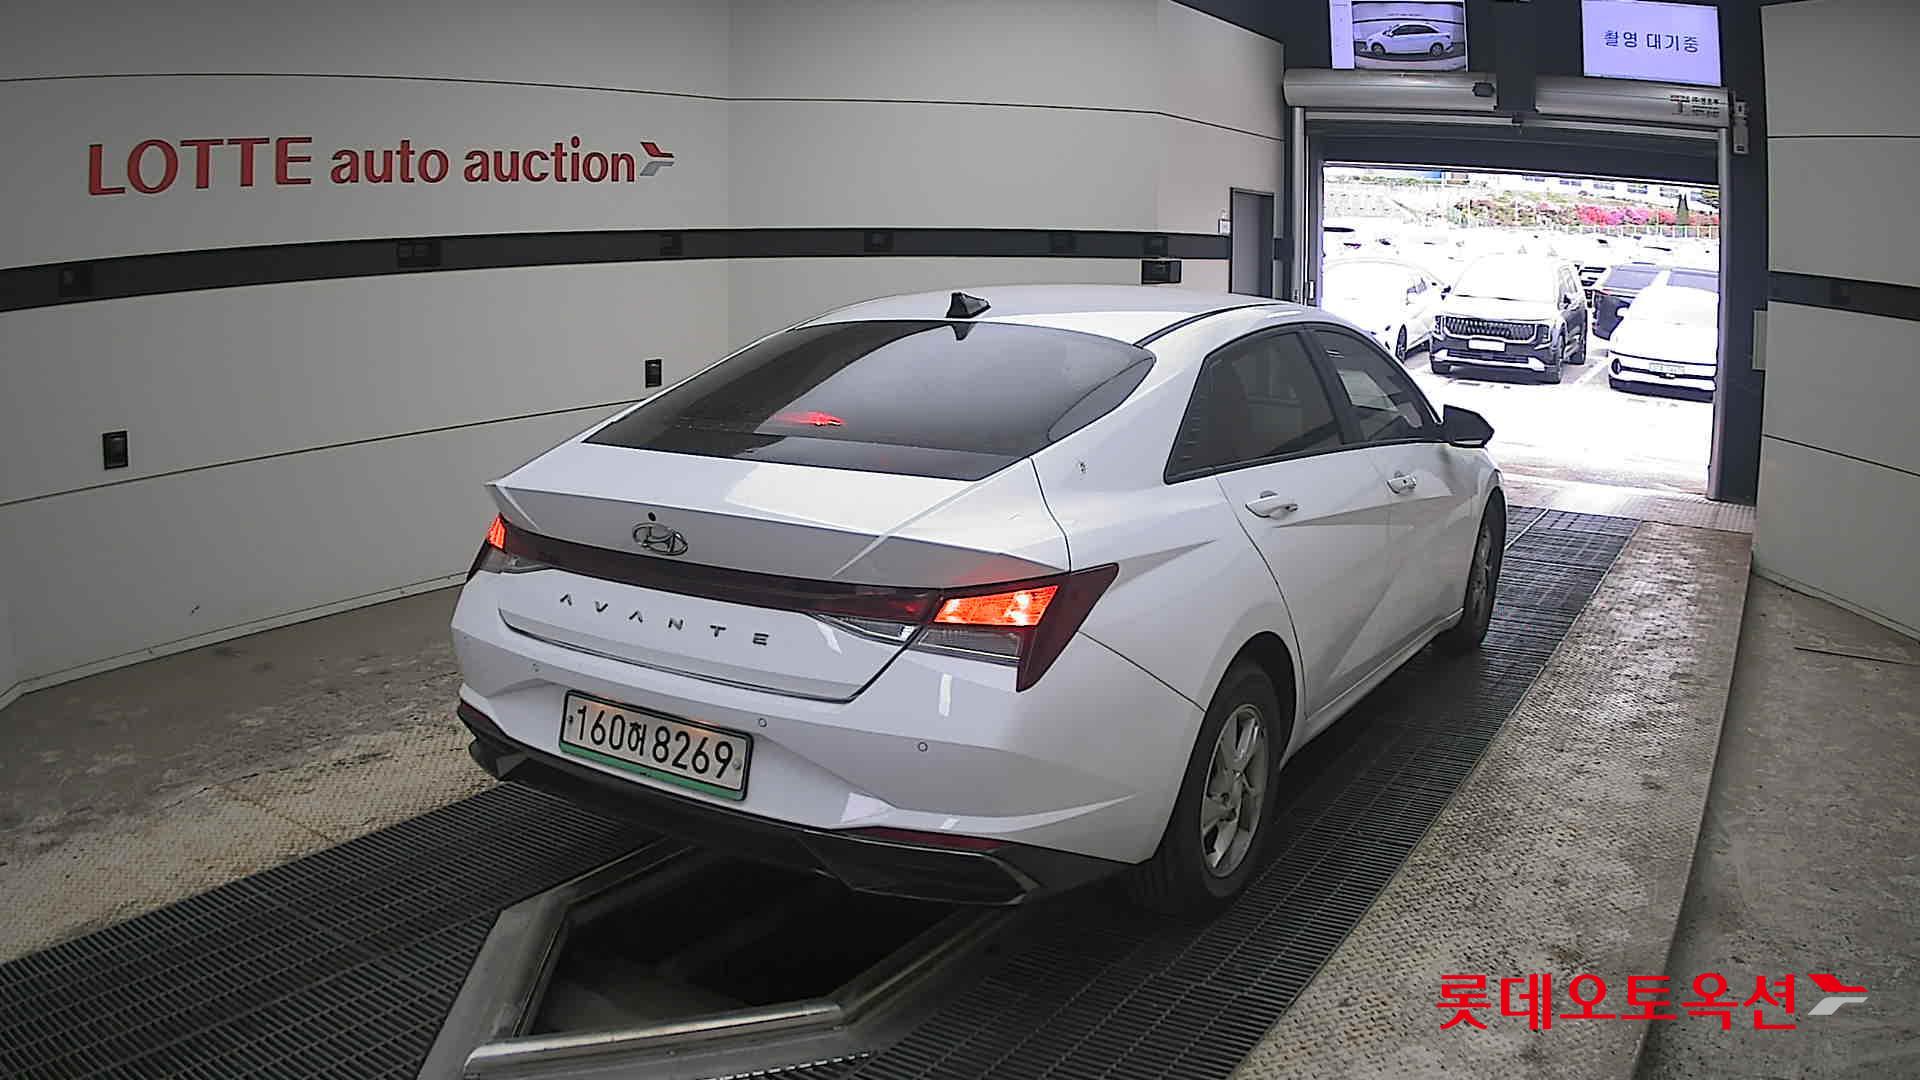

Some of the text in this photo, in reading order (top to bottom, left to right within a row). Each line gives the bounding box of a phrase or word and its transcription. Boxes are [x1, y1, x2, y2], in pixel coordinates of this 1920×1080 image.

[1604, 30, 1698, 53] 촬영 대기중
[88, 136, 637, 196] LOTTE auto auction
[560, 593, 769, 646] AVANTE
